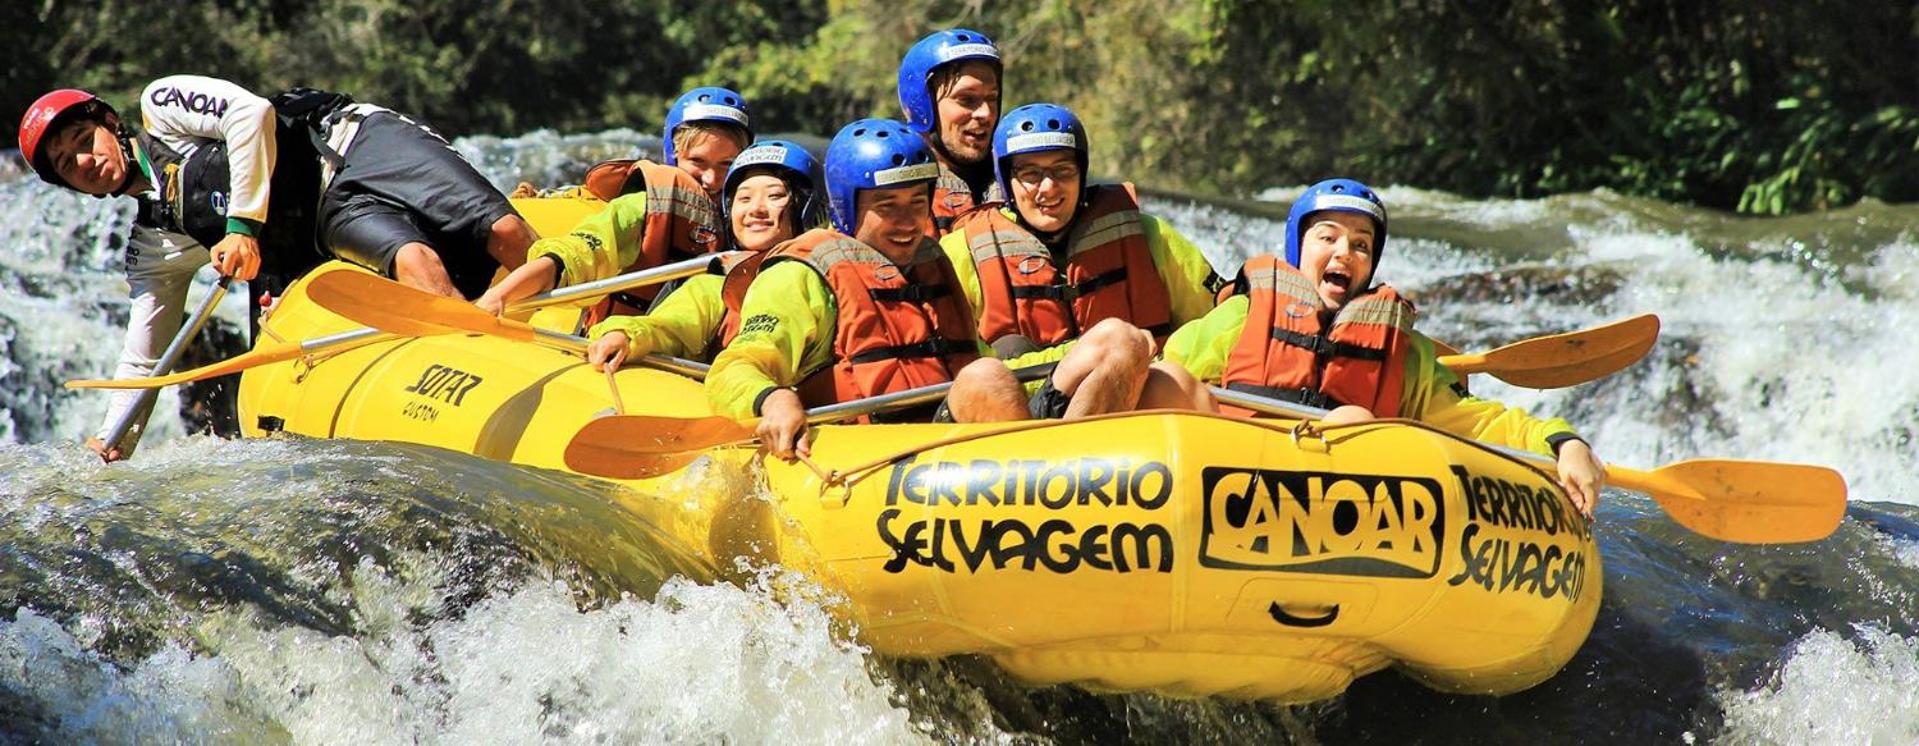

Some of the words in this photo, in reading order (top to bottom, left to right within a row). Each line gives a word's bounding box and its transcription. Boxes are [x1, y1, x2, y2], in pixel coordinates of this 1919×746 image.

[404, 363, 483, 407] SOTAR
[876, 508, 1175, 574] SELVAGEM
[1206, 471, 1438, 574] CANOAR
